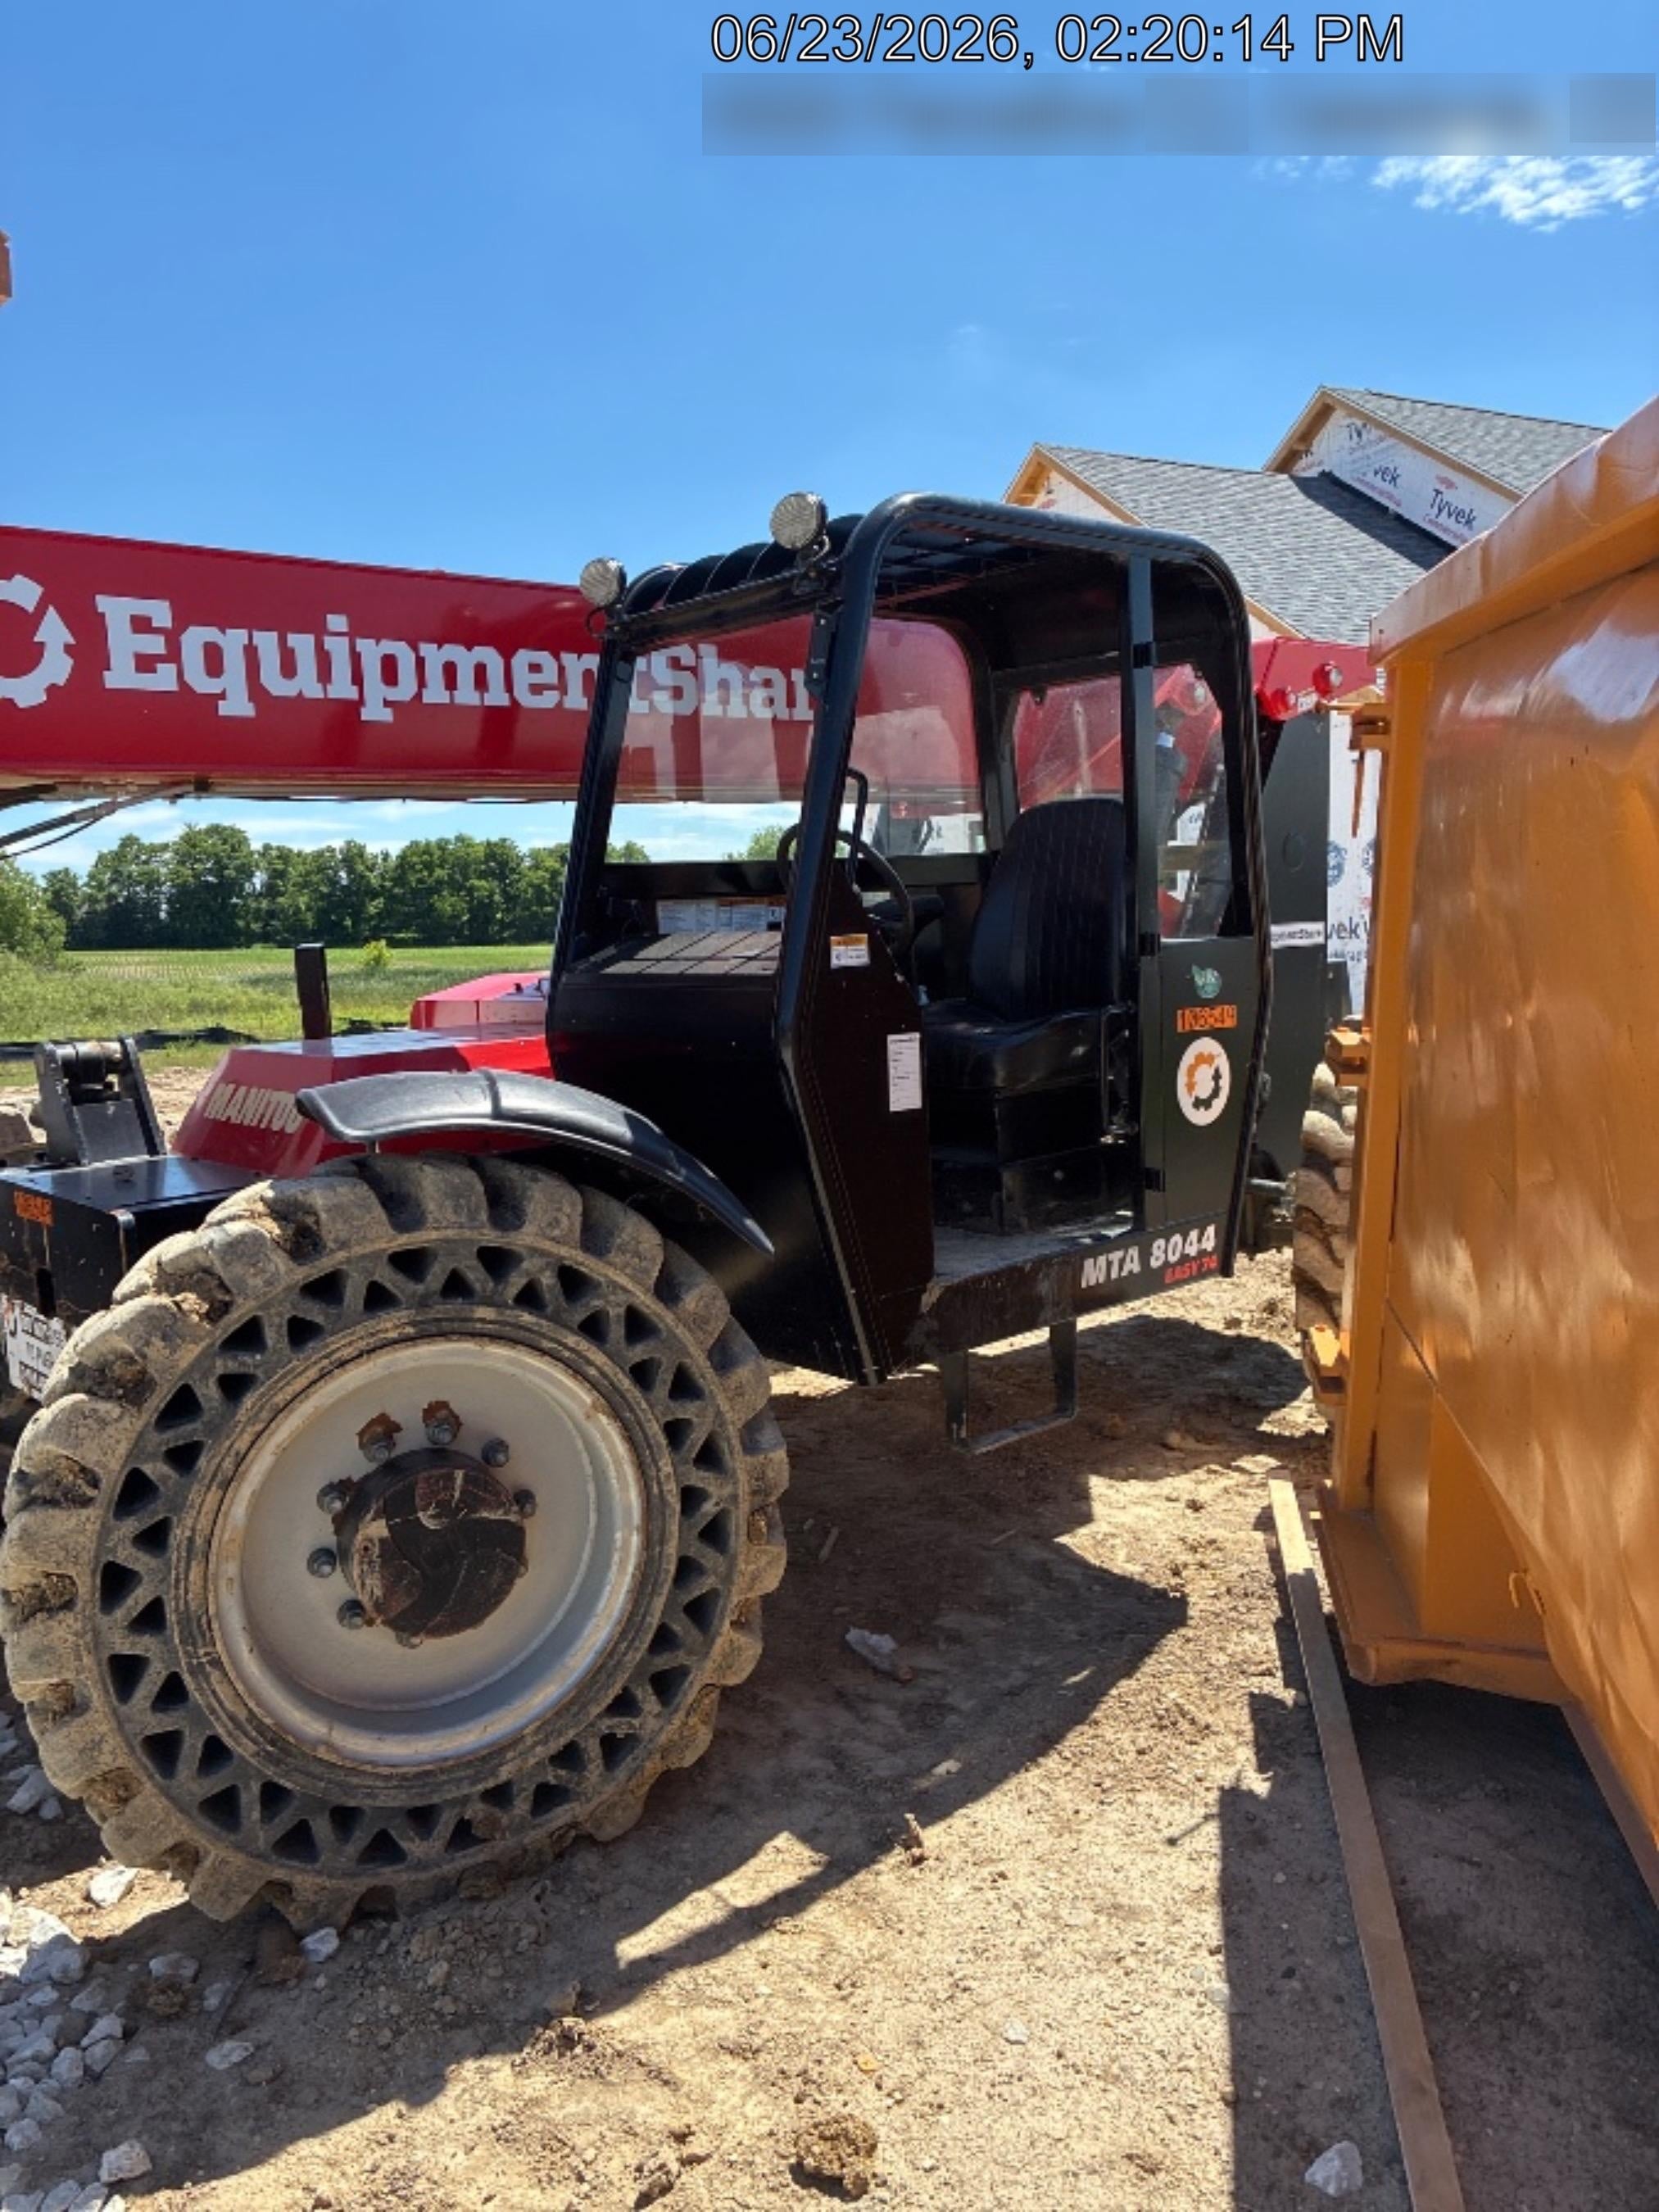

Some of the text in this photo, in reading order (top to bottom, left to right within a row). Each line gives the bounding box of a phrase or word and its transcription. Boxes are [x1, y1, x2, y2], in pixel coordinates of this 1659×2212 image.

[1430, 487, 1476, 532] Tyvek
[205, 1083, 303, 1134] MANITOU
[1081, 1223, 1216, 1289] MTA 8044
